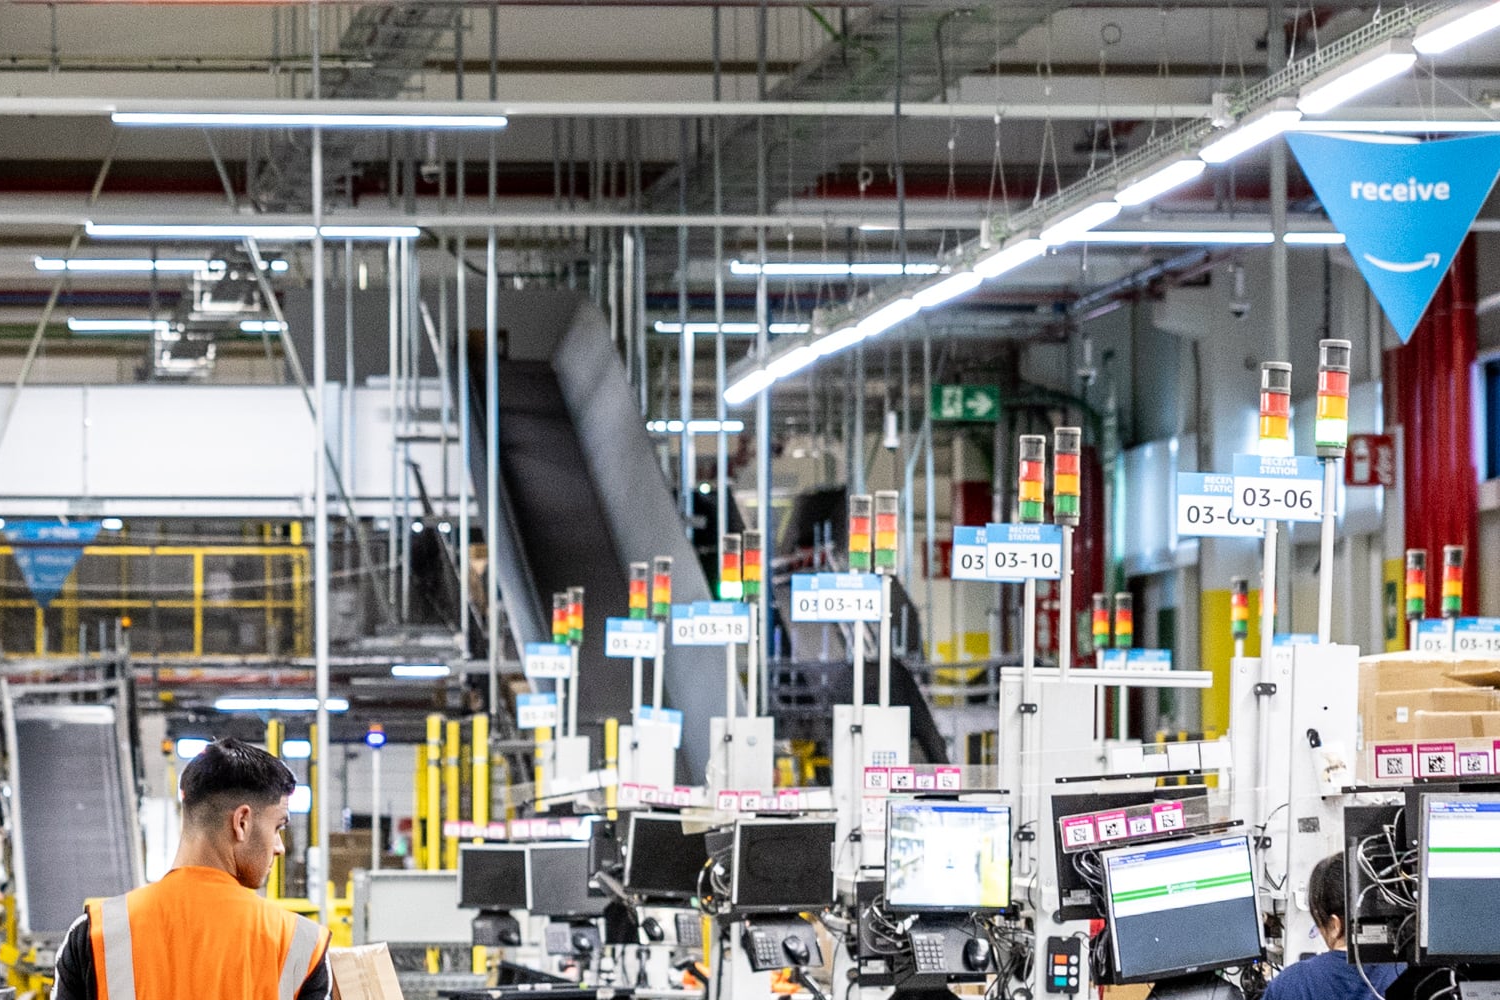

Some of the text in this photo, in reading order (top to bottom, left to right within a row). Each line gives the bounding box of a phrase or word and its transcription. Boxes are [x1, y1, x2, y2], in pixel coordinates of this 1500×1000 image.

[1350, 177, 1450, 202] receive
[1260, 457, 1298, 467] RECEIVE
[1259, 466, 1298, 476] STATION
[1243, 487, 1313, 509] 03-06
[995, 552, 1053, 568] 03-10
[824, 597, 874, 611] 03-14
[699, 623, 743, 636] 03-18
